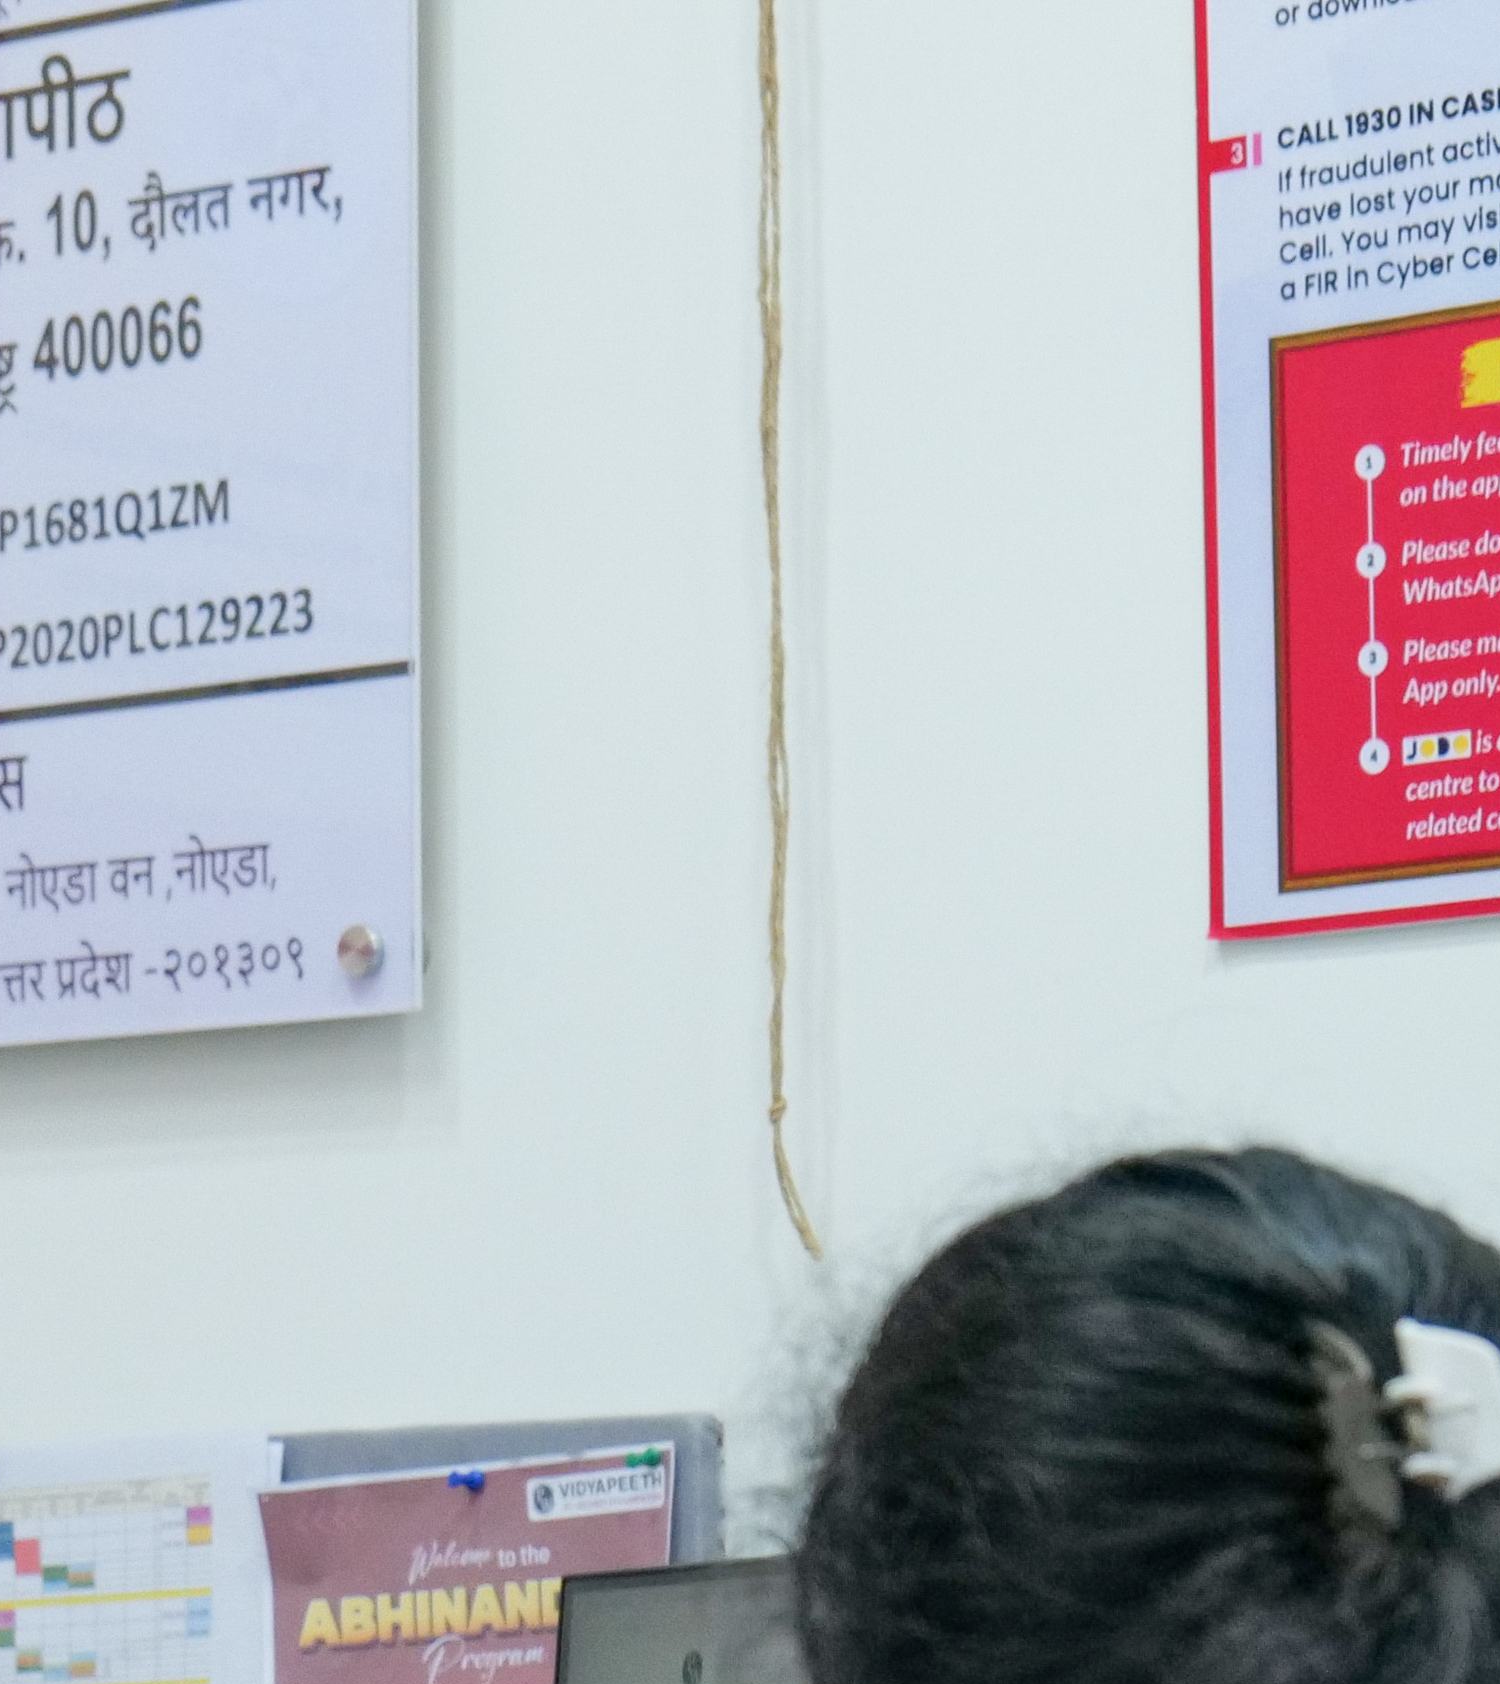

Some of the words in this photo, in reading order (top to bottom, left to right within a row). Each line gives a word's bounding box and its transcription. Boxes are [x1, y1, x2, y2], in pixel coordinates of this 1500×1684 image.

[1277, 118, 1339, 151] CALL
[1344, 104, 1402, 139] 1930
[1408, 98, 1435, 127] IN
[1278, 166, 1293, 193] If
[1299, 143, 1435, 190] fraudulent
[1278, 200, 1342, 230] have
[1349, 187, 1396, 217] lost
[1402, 178, 1461, 216] your
[1279, 233, 1333, 266] Cell.
[1340, 229, 1389, 254] You
[1397, 216, 1455, 246] may
[1279, 280, 1297, 303] a
[1304, 268, 1339, 299] FIR
[1346, 264, 1369, 291] in
[1376, 252, 1455, 291] Cyber
[1400, 433, 1473, 469] Timely
[1398, 484, 1428, 508] on
[1431, 474, 1468, 503] the
[497, 1548, 516, 1569] to
